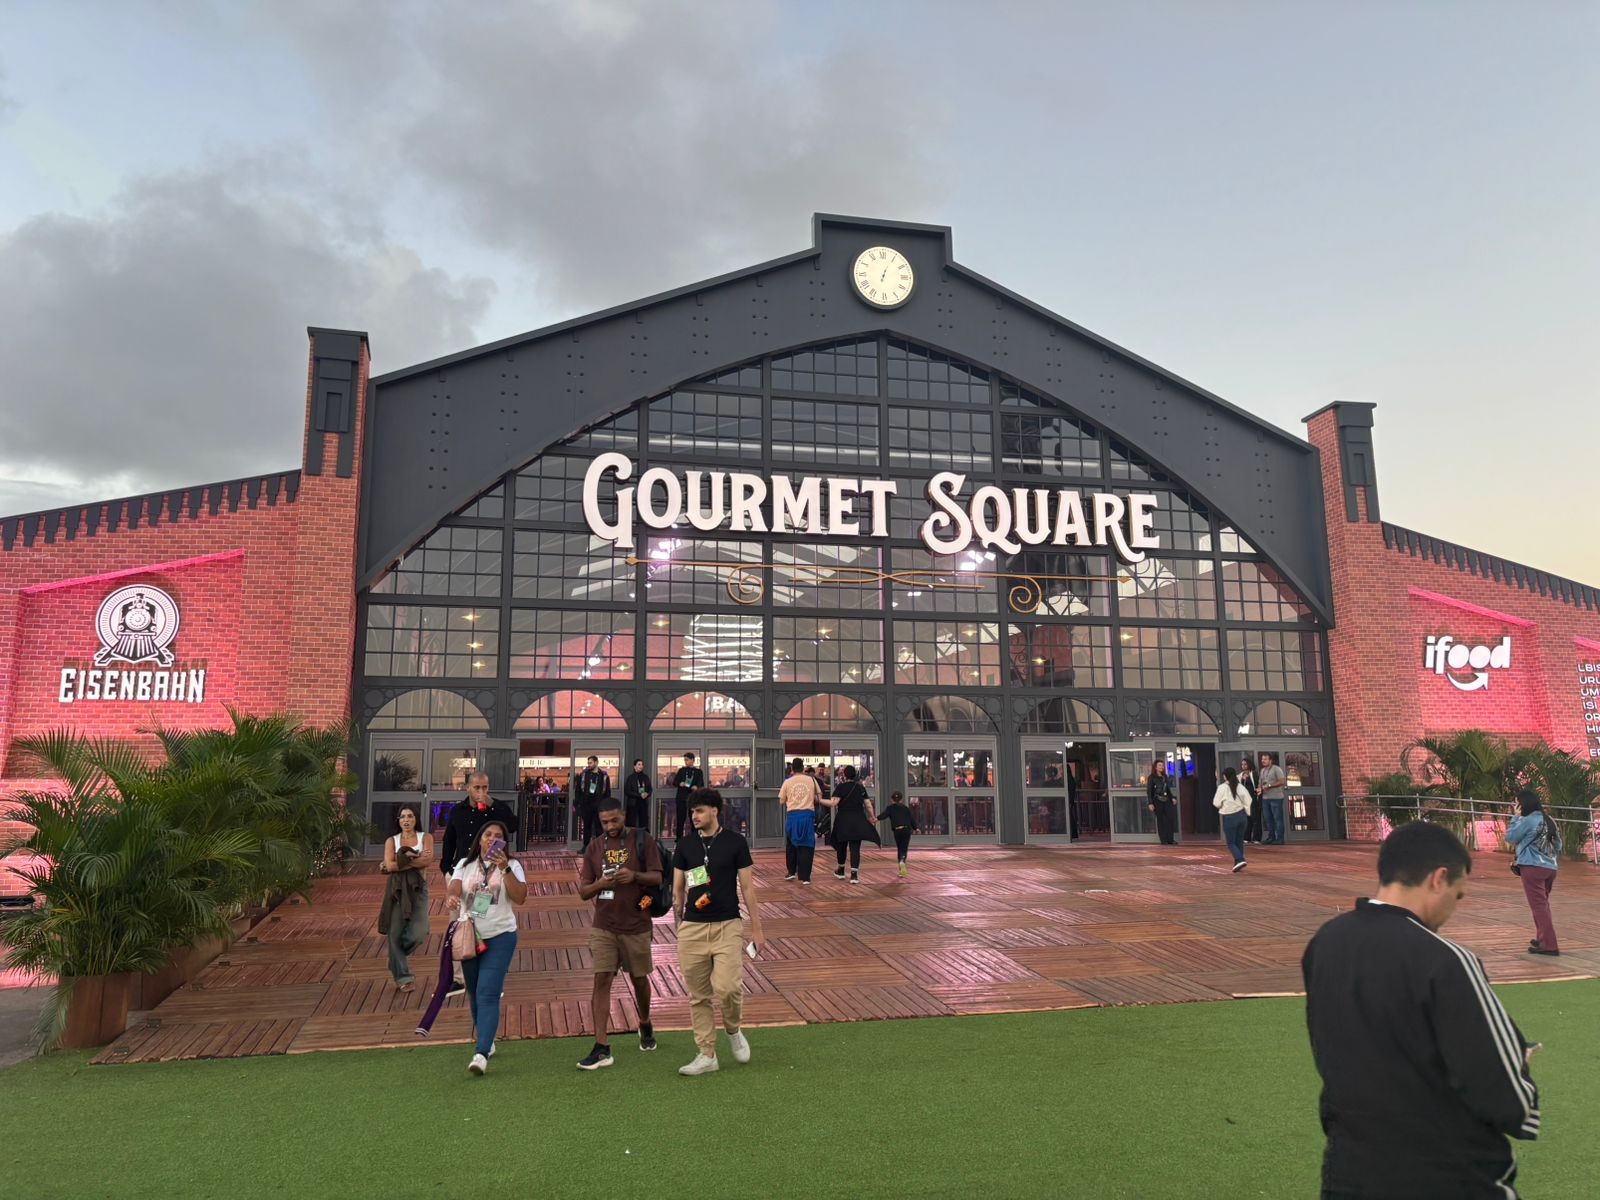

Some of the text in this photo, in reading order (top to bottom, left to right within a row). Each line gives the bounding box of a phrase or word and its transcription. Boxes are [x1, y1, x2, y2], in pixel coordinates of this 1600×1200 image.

[583, 452, 1161, 563] GOURMET SQUARE
[58, 668, 206, 703] EISENBAHN
